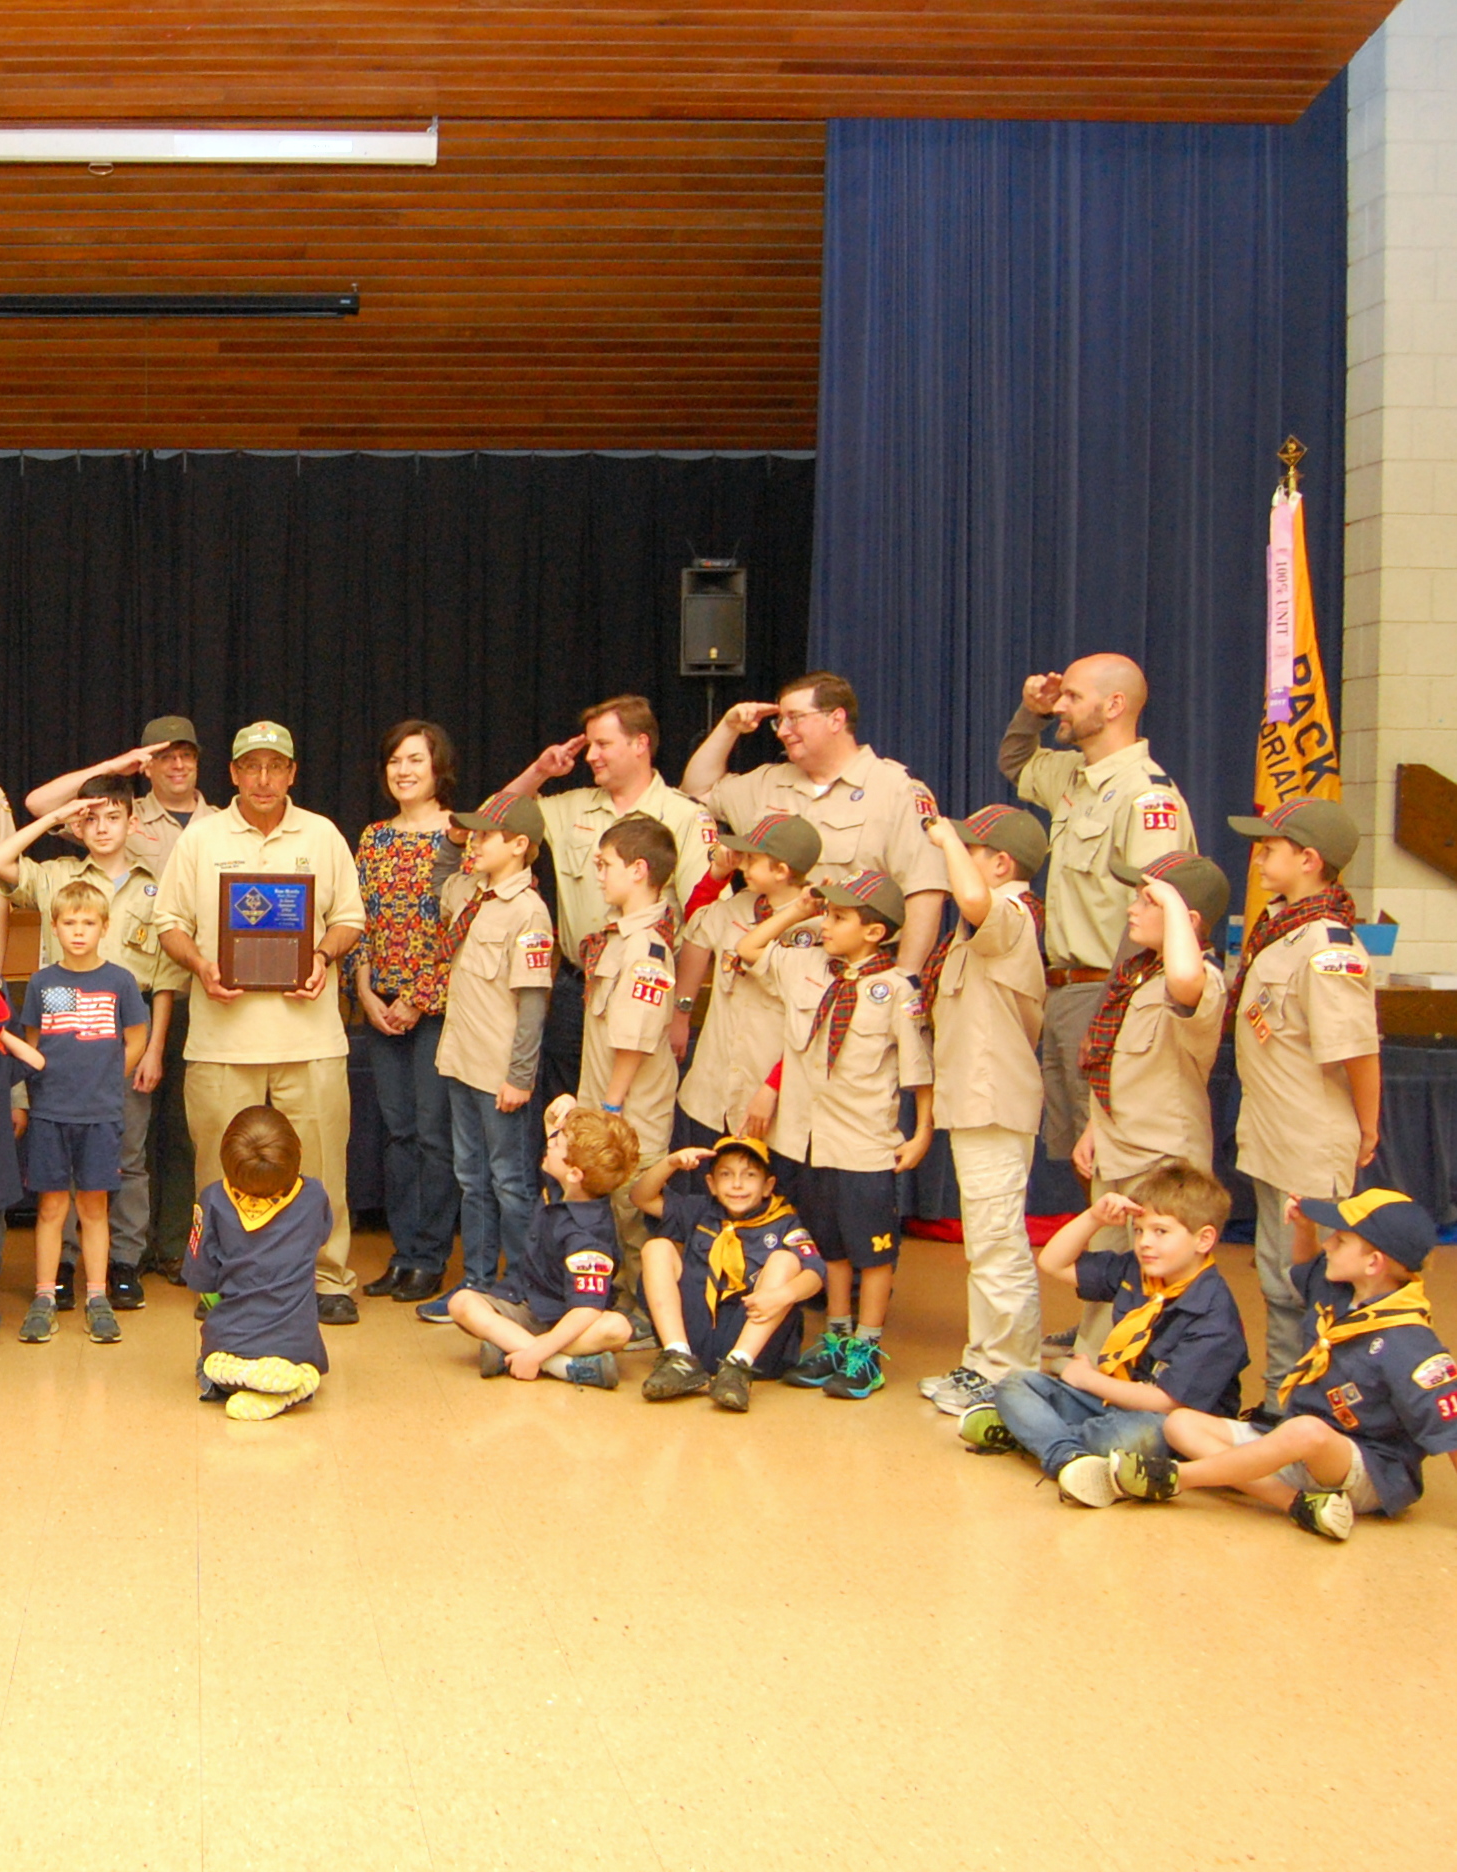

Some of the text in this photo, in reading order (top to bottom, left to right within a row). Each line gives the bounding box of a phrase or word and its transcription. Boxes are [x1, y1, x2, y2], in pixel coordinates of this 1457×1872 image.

[1276, 561, 1288, 595] 100%
[1276, 600, 1289, 637] UNIT
[1288, 653, 1340, 794] PACK
[1261, 709, 1301, 803] ORIAL
[1144, 812, 1176, 829] 310
[526, 953, 549, 968] 310
[634, 982, 662, 1005] 310
[871, 1232, 892, 1252] M
[576, 1276, 604, 1292] 310
[1437, 1393, 1457, 1417] 31
